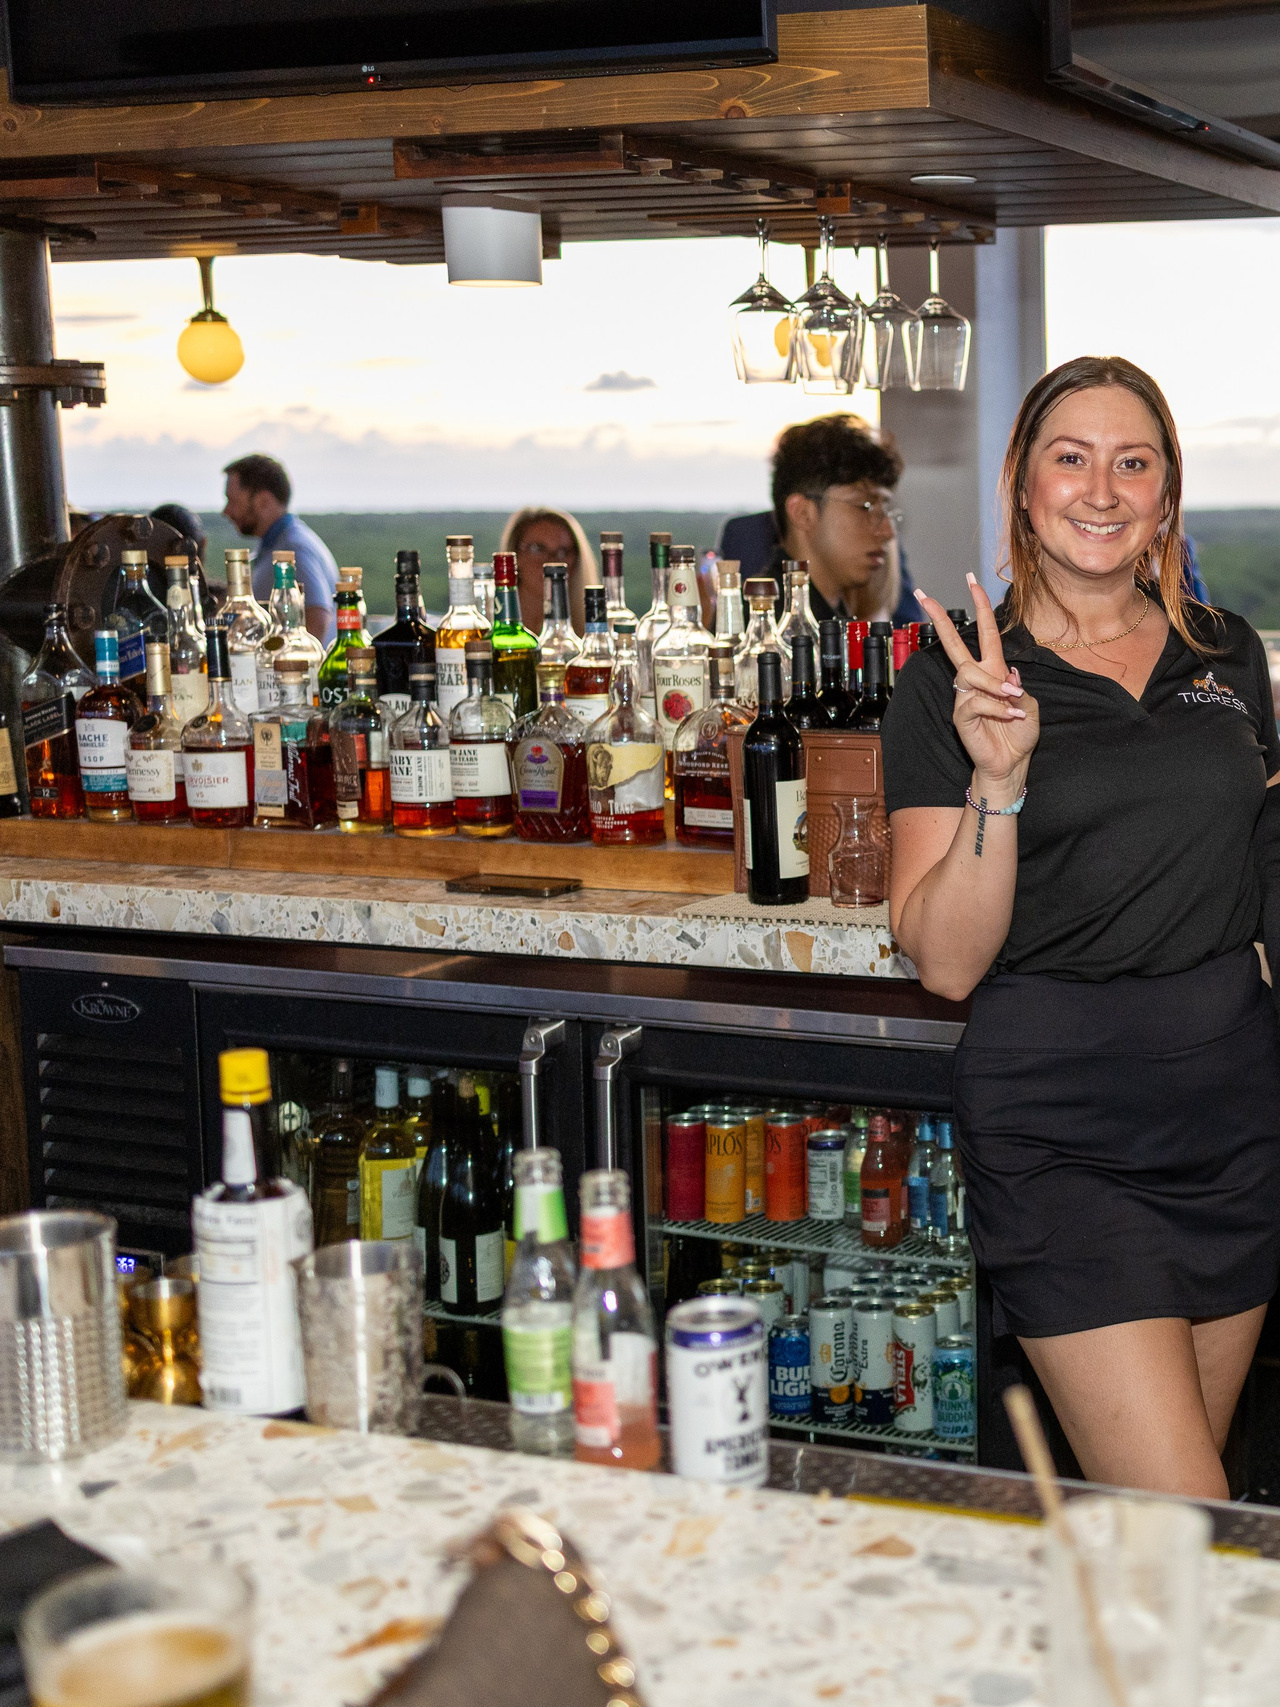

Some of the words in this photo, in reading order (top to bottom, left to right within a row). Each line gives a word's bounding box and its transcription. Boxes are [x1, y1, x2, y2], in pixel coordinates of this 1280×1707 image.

[672, 674, 702, 687] Roses
[320, 686, 351, 704] OST
[1178, 691, 1248, 715] TIGRESS
[42, 788, 51, 797] 12
[607, 799, 636, 816] TRACE
[830, 1320, 849, 1383] Corona
[859, 1339, 869, 1369] Extra
[898, 1350, 908, 1404] STELLA
[770, 1380, 812, 1397] LIGH
